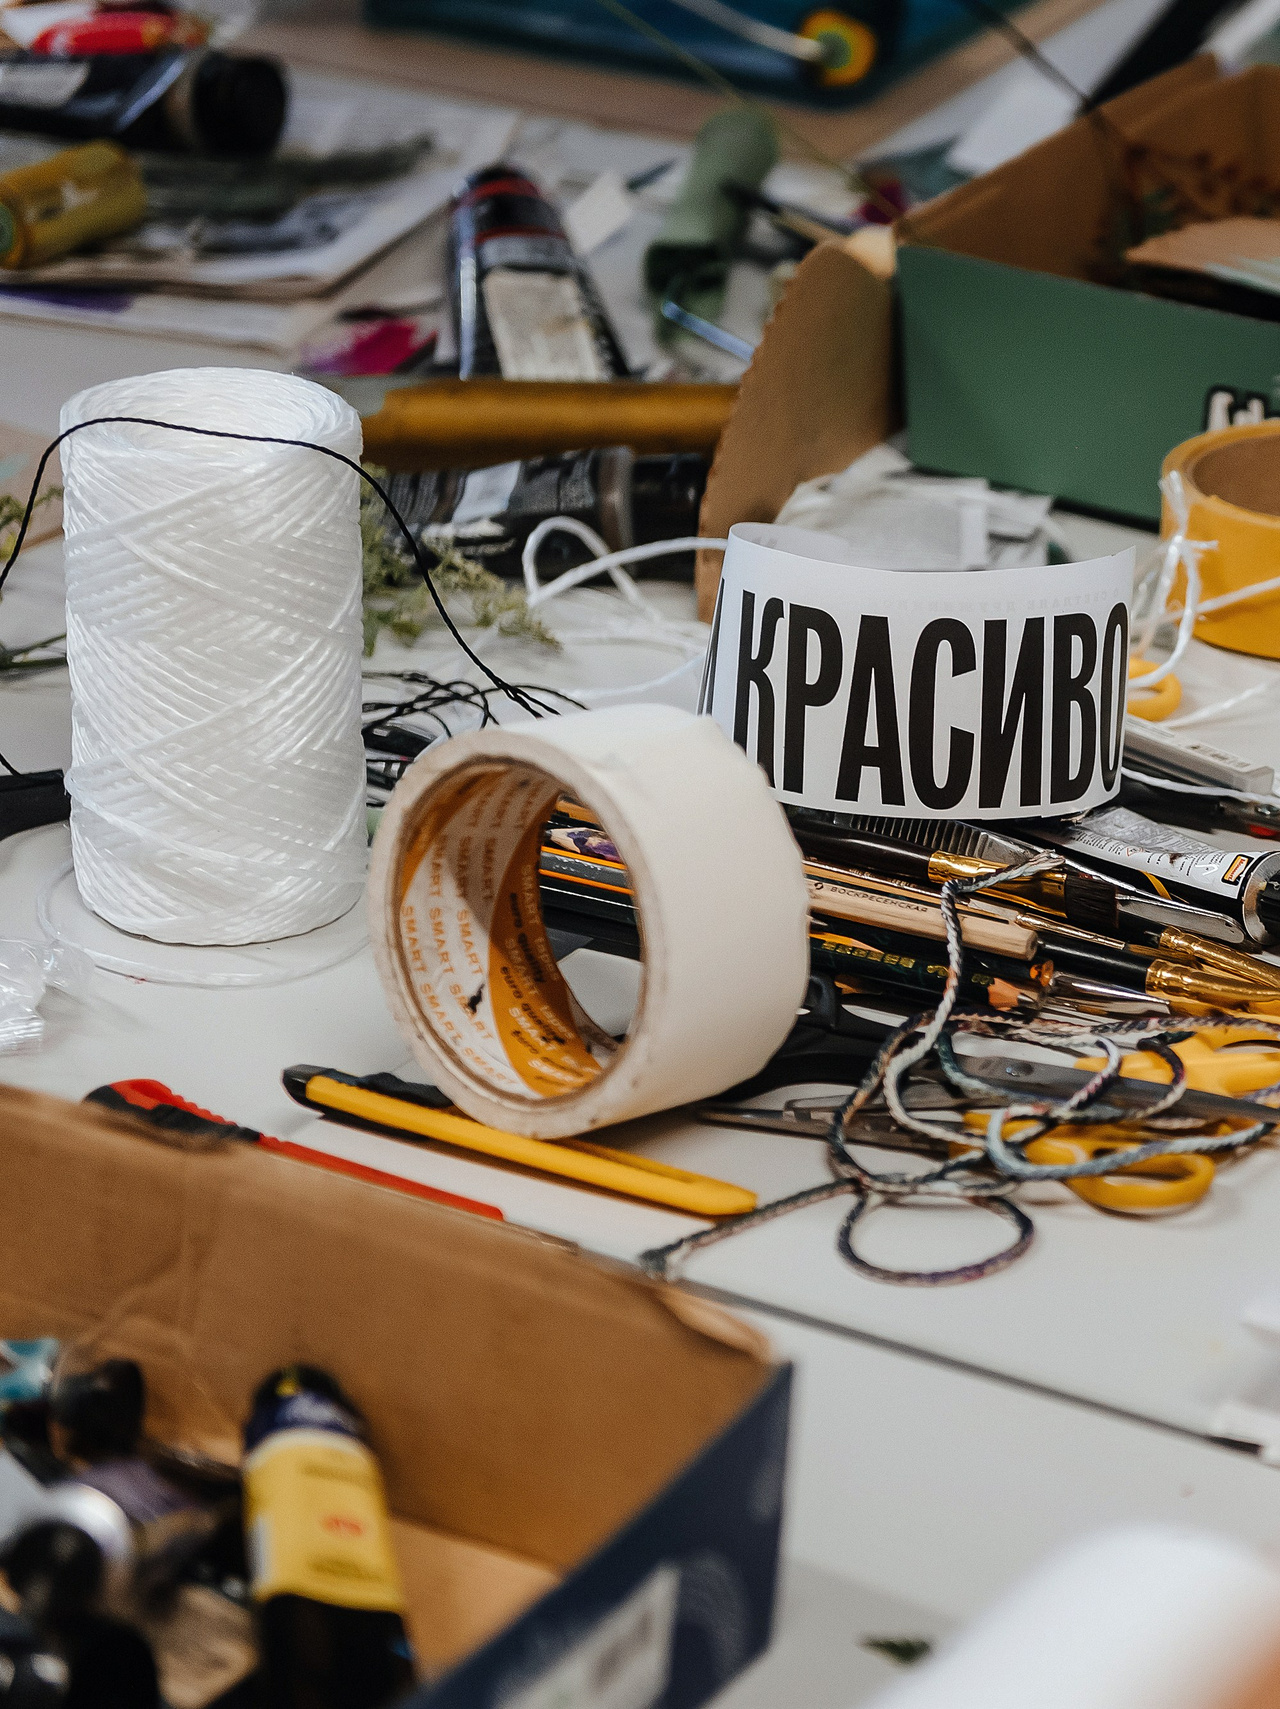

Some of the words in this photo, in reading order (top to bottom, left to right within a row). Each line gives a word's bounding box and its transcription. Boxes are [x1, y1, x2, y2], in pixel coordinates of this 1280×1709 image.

[734, 589, 1129, 810] КРАСИВО
[429, 833, 449, 897] SMART
[520, 862, 540, 925] SMART
[829, 886, 929, 914] ВОСКРЕСЕНСКАЯ
[429, 907, 455, 975] SMART
[457, 909, 484, 975] SMART
[402, 905, 428, 974] SMART
[420, 982, 464, 1043] SMART
[463, 1047, 519, 1085] SMART
[501, 965, 523, 999] euro
[504, 937, 540, 996] SMART
[540, 1004, 574, 1040] tapes
[508, 1006, 558, 1052] SMART
